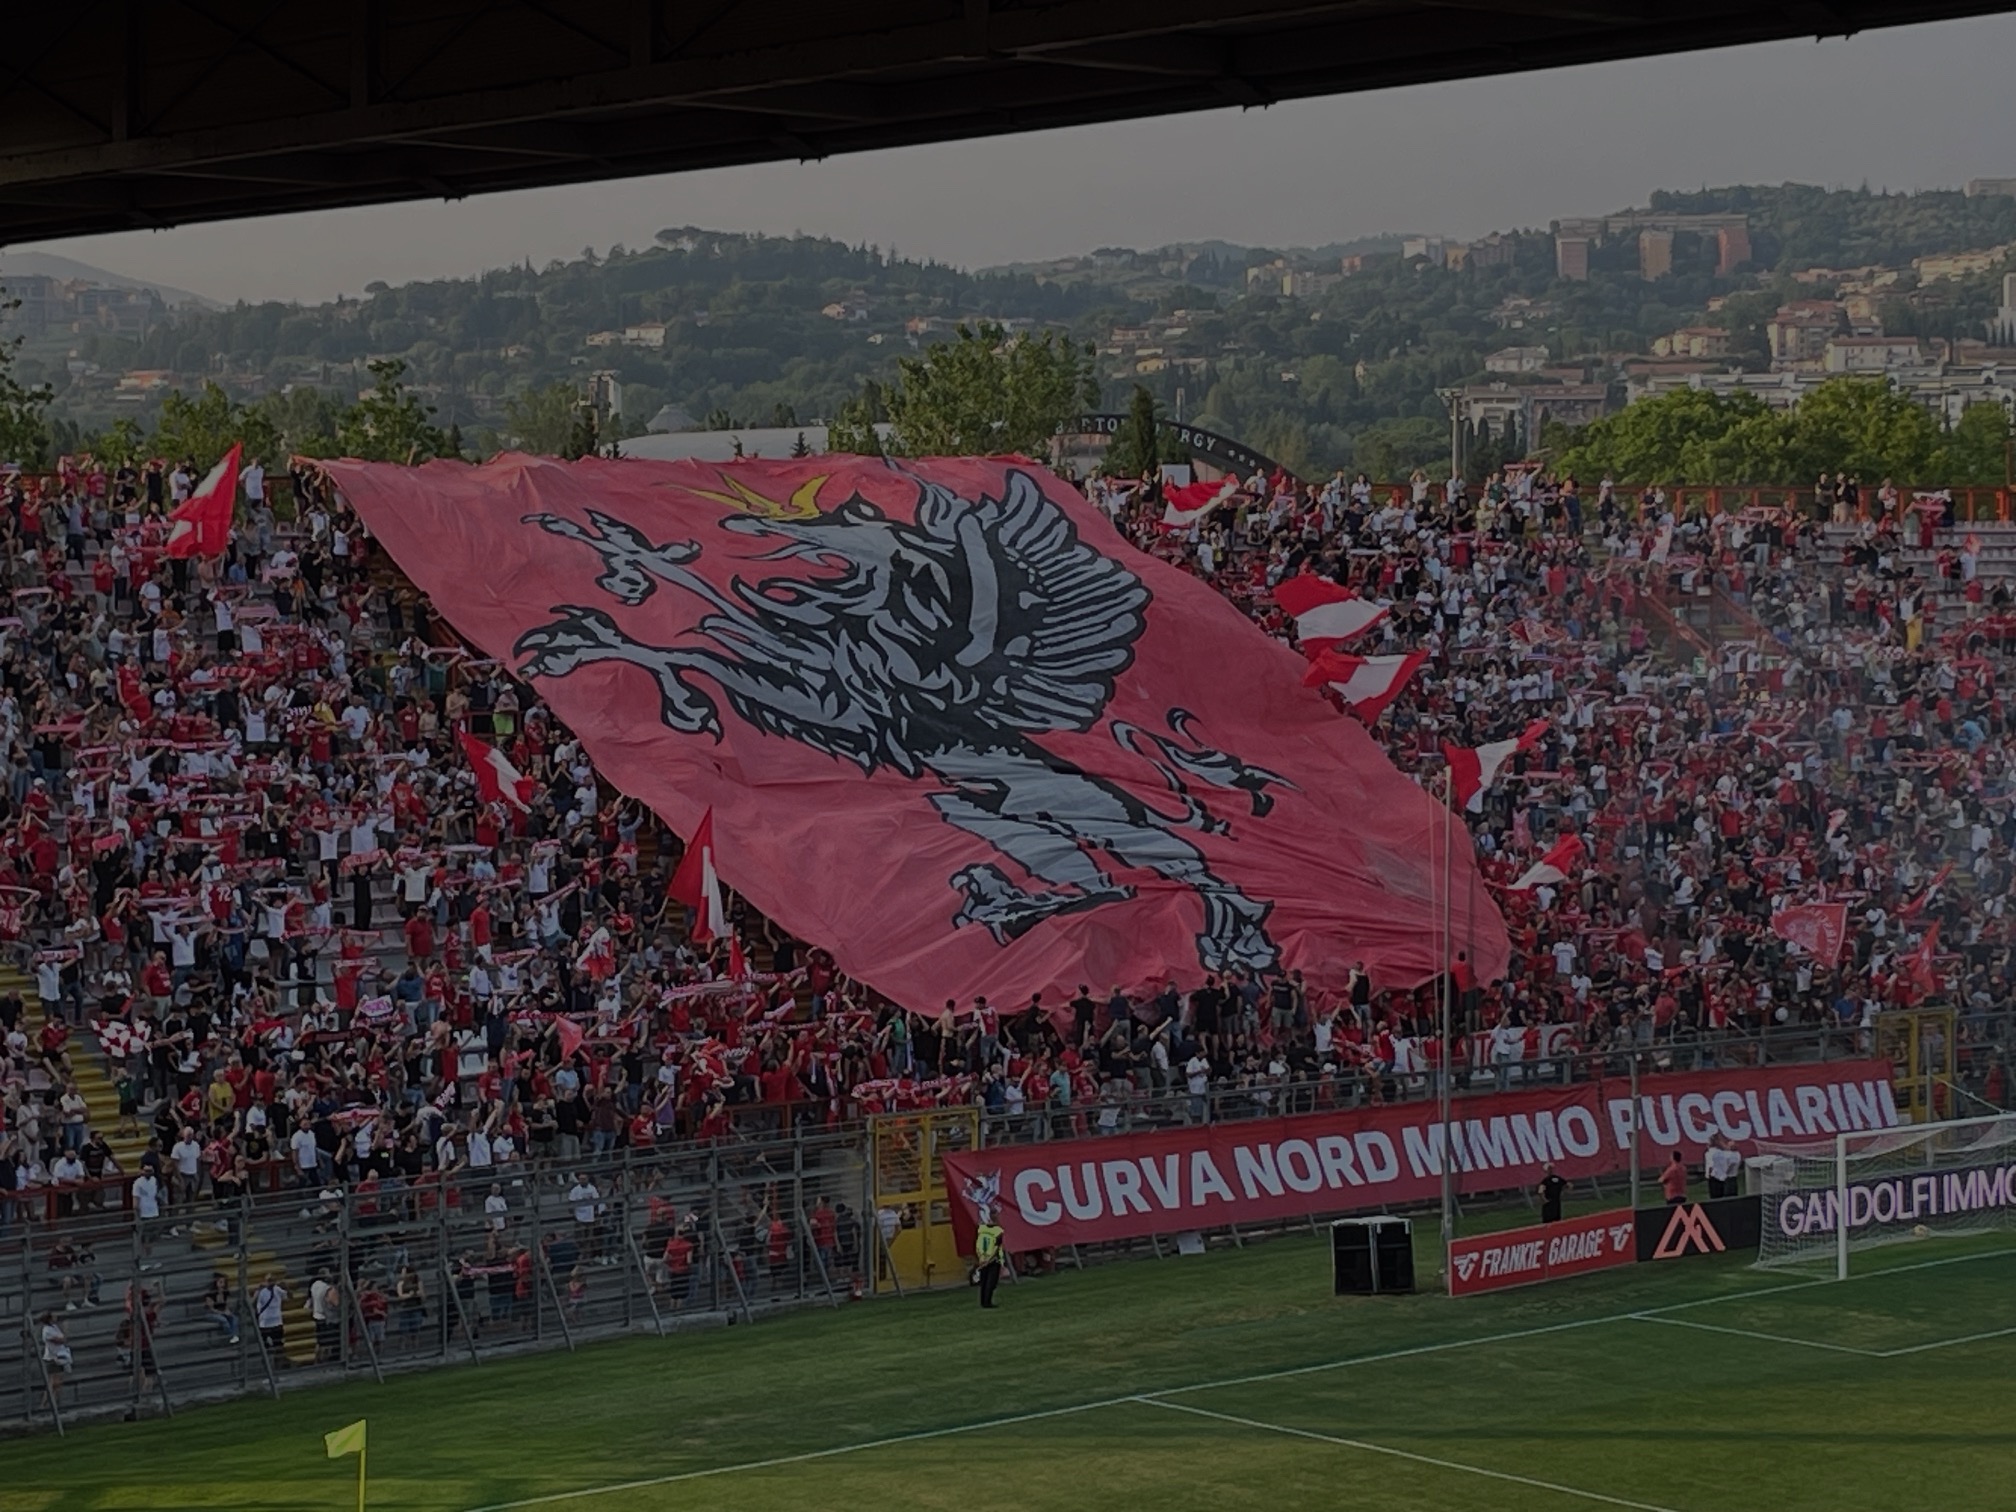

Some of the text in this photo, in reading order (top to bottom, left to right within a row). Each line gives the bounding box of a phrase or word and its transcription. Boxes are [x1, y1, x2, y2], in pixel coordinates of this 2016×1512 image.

[1013, 1079, 1899, 1227] CURVA NORD MIMMO PUCCIARINI
[1779, 1176, 1937, 1236] GANDOLFI
[1479, 1228, 1605, 1279] FRANKIE GARAGE
